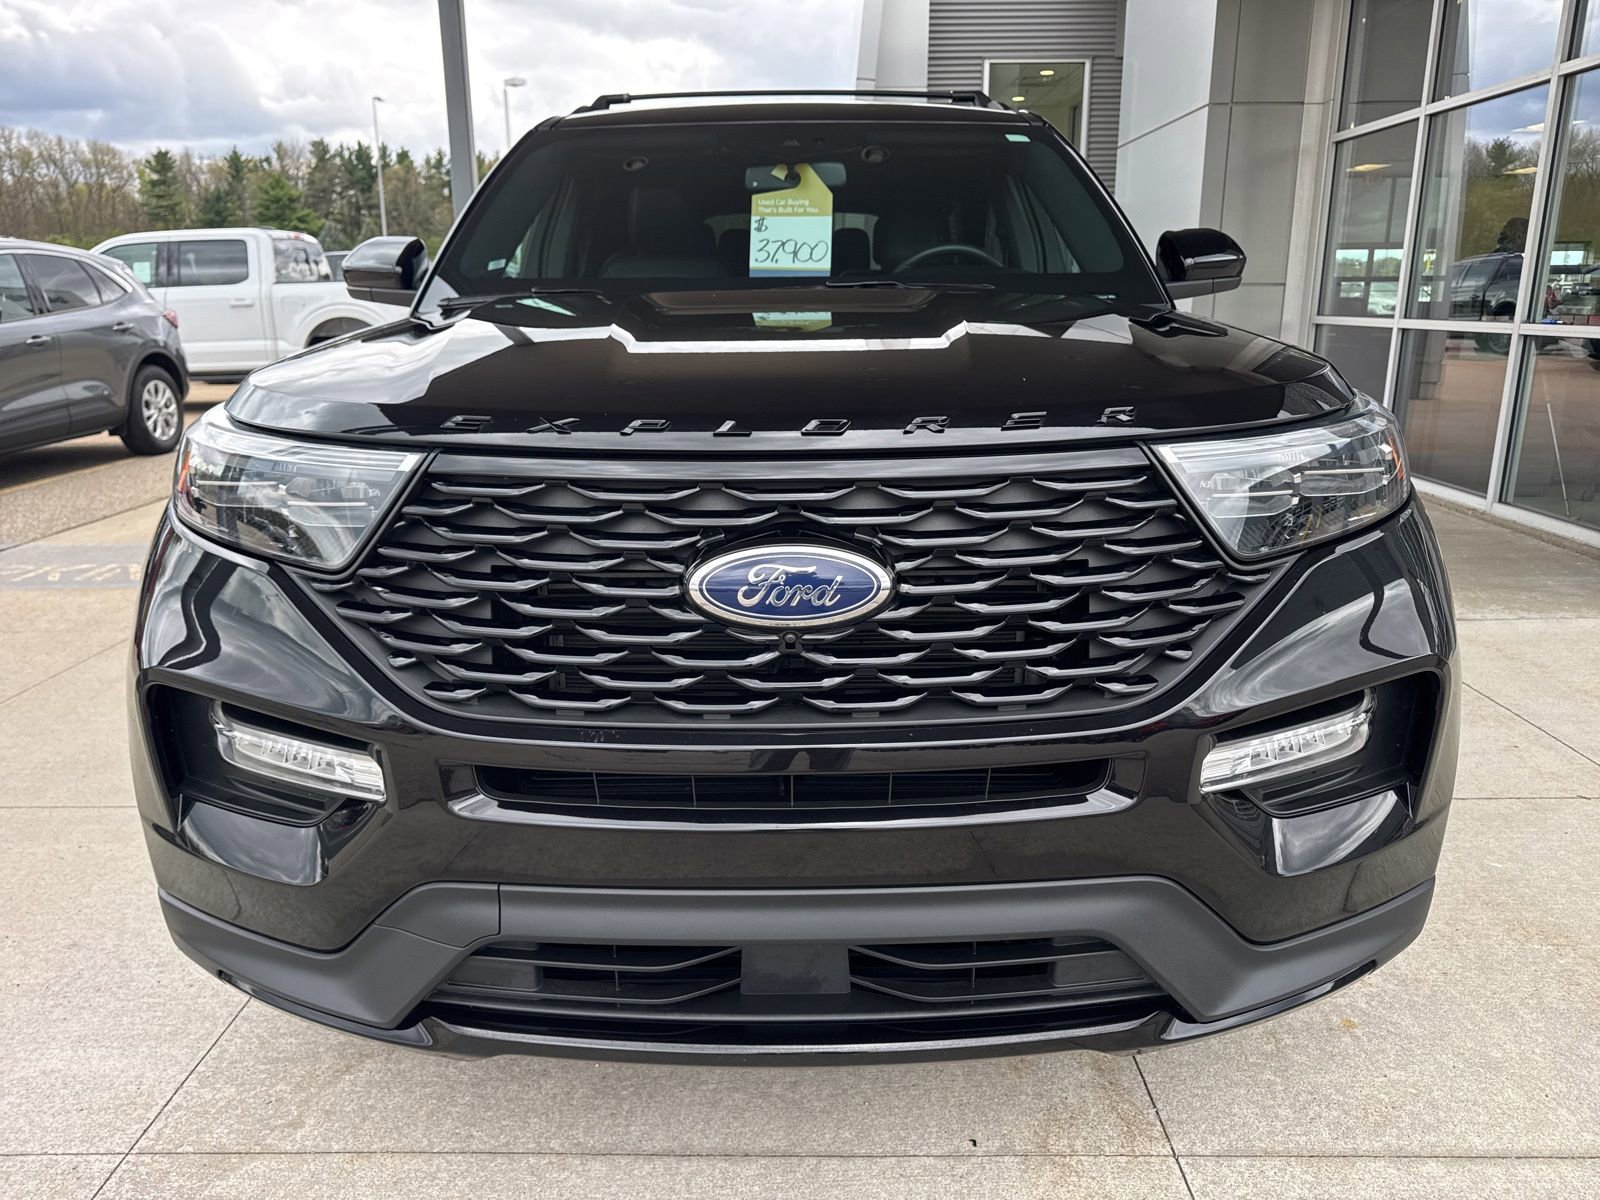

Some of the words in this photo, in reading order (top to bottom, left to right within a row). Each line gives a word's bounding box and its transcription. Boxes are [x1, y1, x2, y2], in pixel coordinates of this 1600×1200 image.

[787, 198, 810, 207] Buying
[754, 217, 768, 232] $
[440, 406, 1136, 437] EXPLORER
[737, 563, 843, 608] Ford
